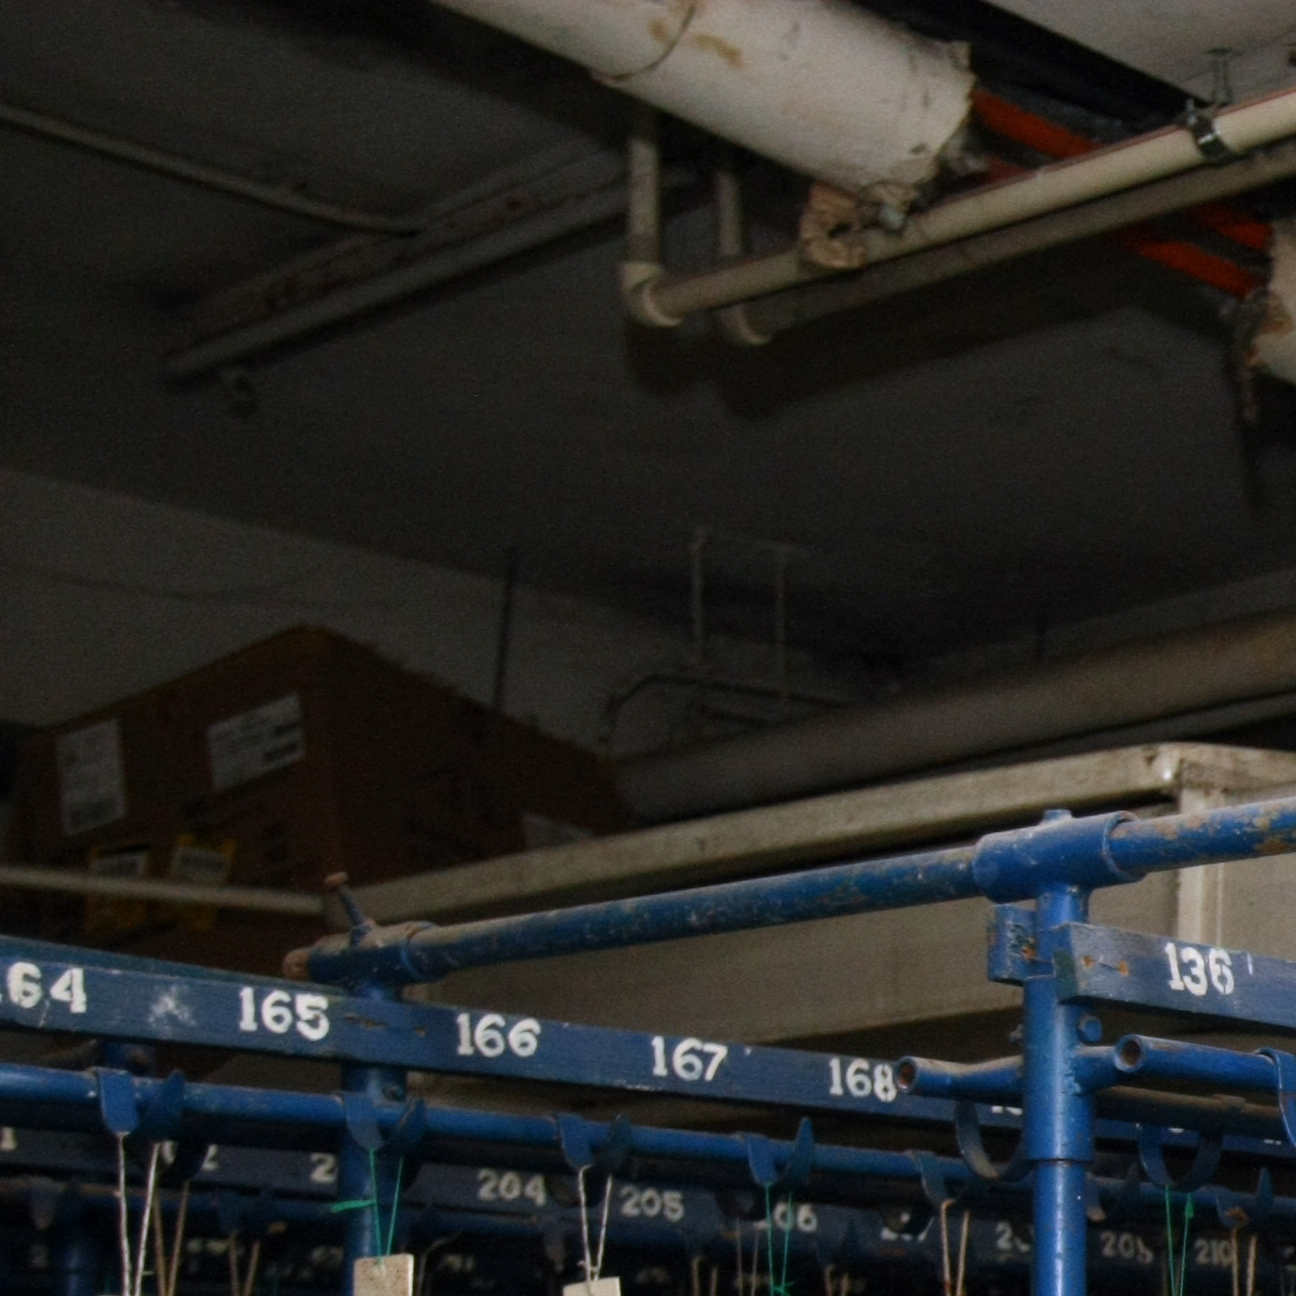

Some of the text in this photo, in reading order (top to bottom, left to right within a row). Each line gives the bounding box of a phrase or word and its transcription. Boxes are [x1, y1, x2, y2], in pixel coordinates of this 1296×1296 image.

[0, 961, 87, 1014] 64
[1164, 941, 1235, 996] 136
[238, 985, 330, 1041] 165
[456, 1012, 542, 1058] 166
[650, 1035, 728, 1082] 167
[829, 1056, 898, 1102] 168
[477, 1167, 549, 1207] 204
[619, 1185, 685, 1223] 205
